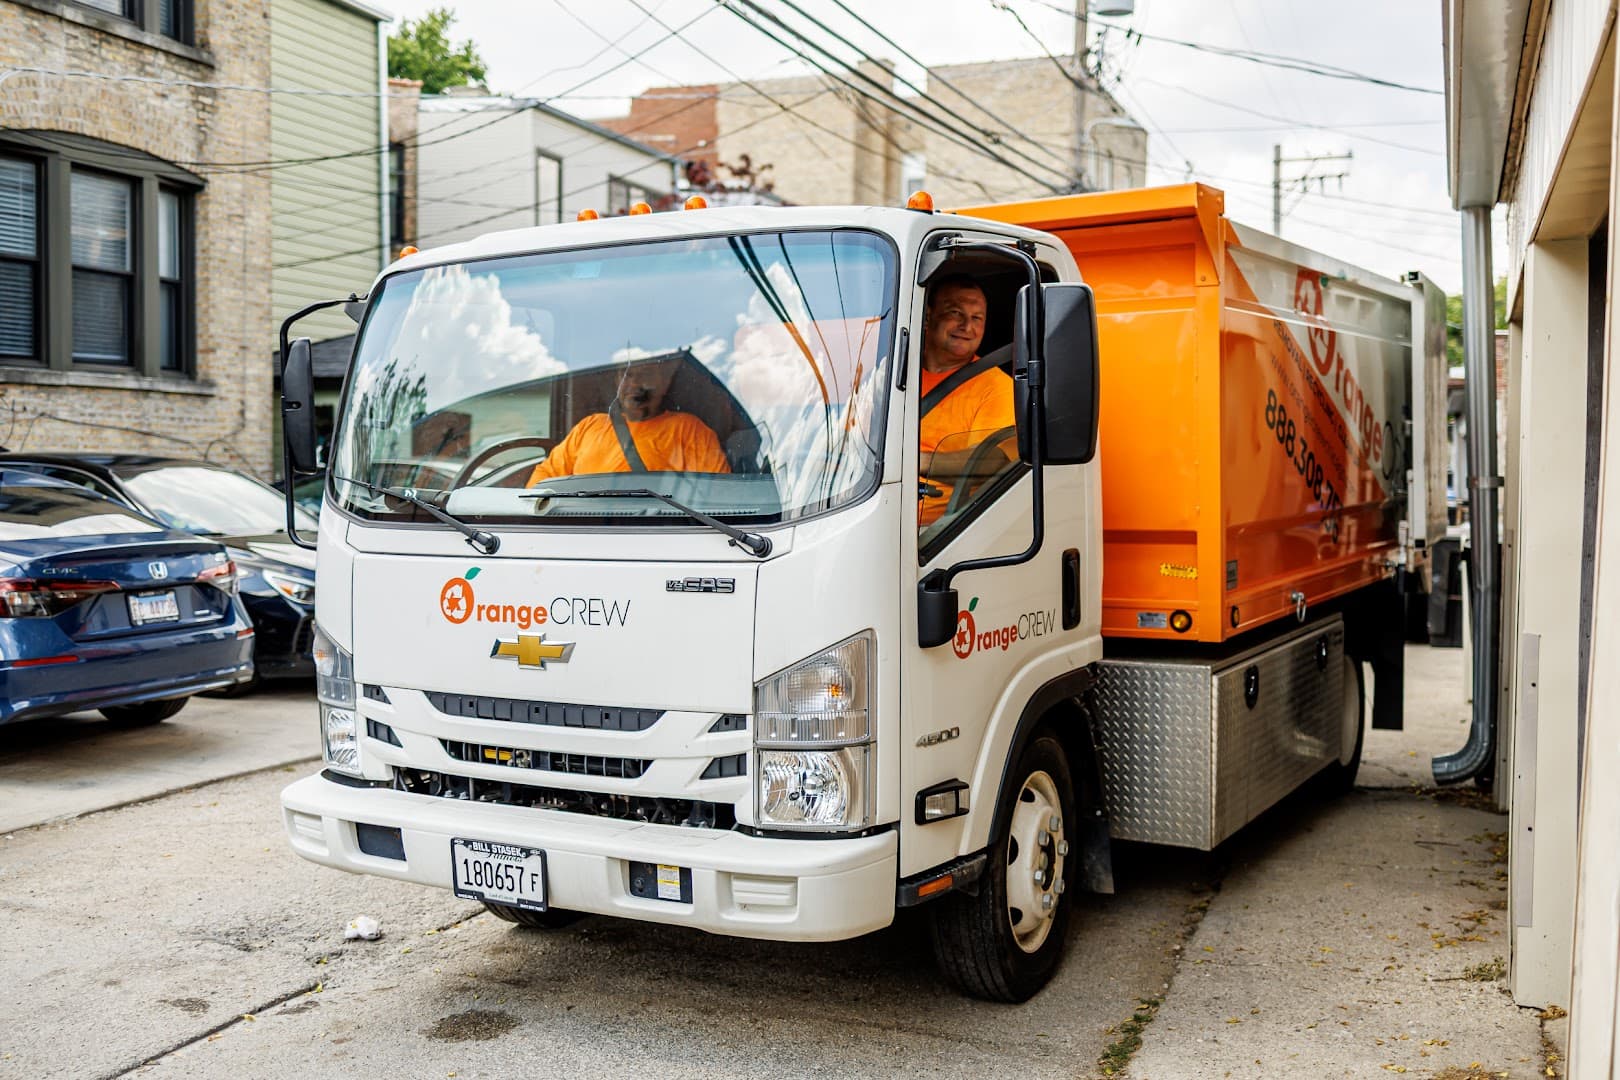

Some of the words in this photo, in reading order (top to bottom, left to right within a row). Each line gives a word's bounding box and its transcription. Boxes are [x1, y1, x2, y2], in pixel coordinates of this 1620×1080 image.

[440, 577, 631, 630] OrangeCREW
[952, 608, 1056, 660] OrangeCREW
[472, 841, 490, 853] BILL
[491, 844, 521, 857] STASEK
[463, 858, 525, 894] 180657
[531, 873, 539, 892] F
